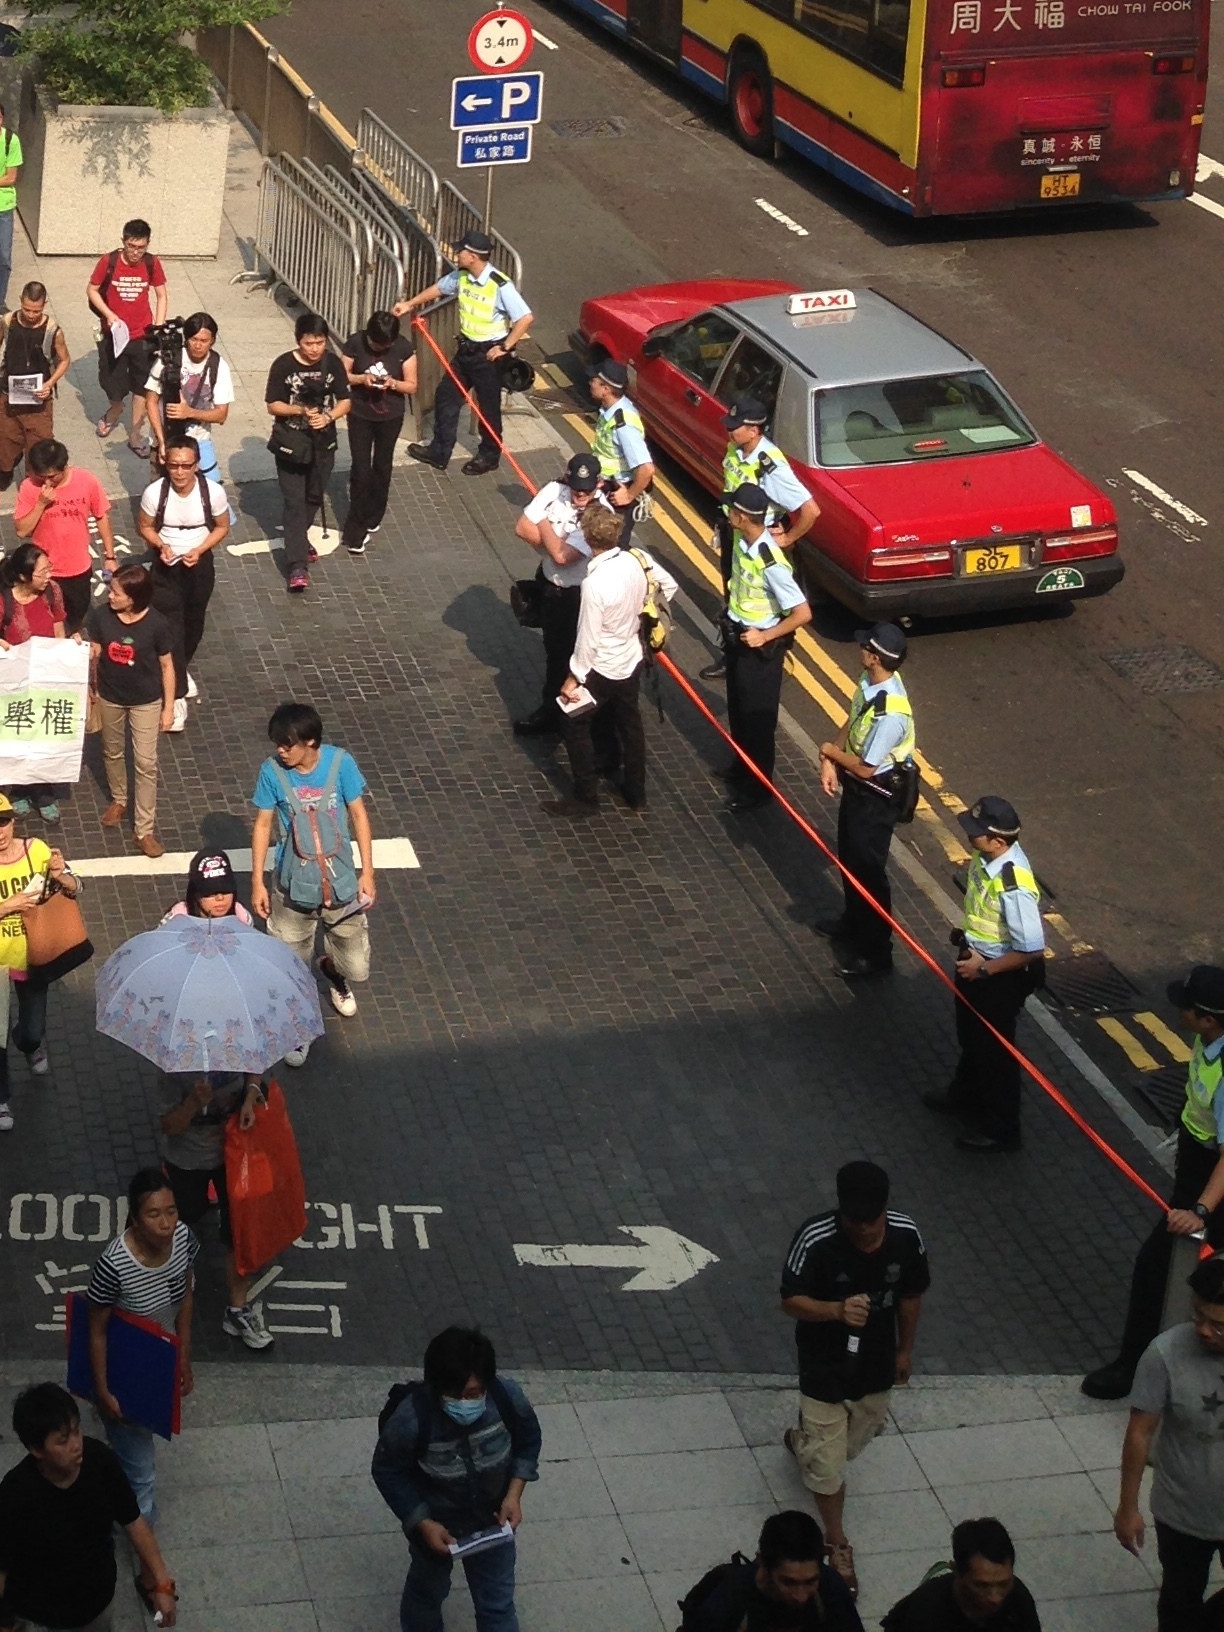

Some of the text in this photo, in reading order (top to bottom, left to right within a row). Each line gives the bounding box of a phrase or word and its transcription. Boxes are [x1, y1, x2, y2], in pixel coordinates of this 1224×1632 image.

[1077, 0, 1192, 17] CHOW TAI FOOK
[483, 36, 519, 49] 3.4m
[500, 81, 531, 119] P
[465, 131, 526, 144] Private Road
[474, 145, 516, 159] 私家路
[1052, 174, 1069, 186] HT
[1043, 184, 1076, 197] 9534
[799, 294, 849, 310] TAXI
[976, 555, 1009, 571] 807
[293, 1202, 443, 1251] GHT
